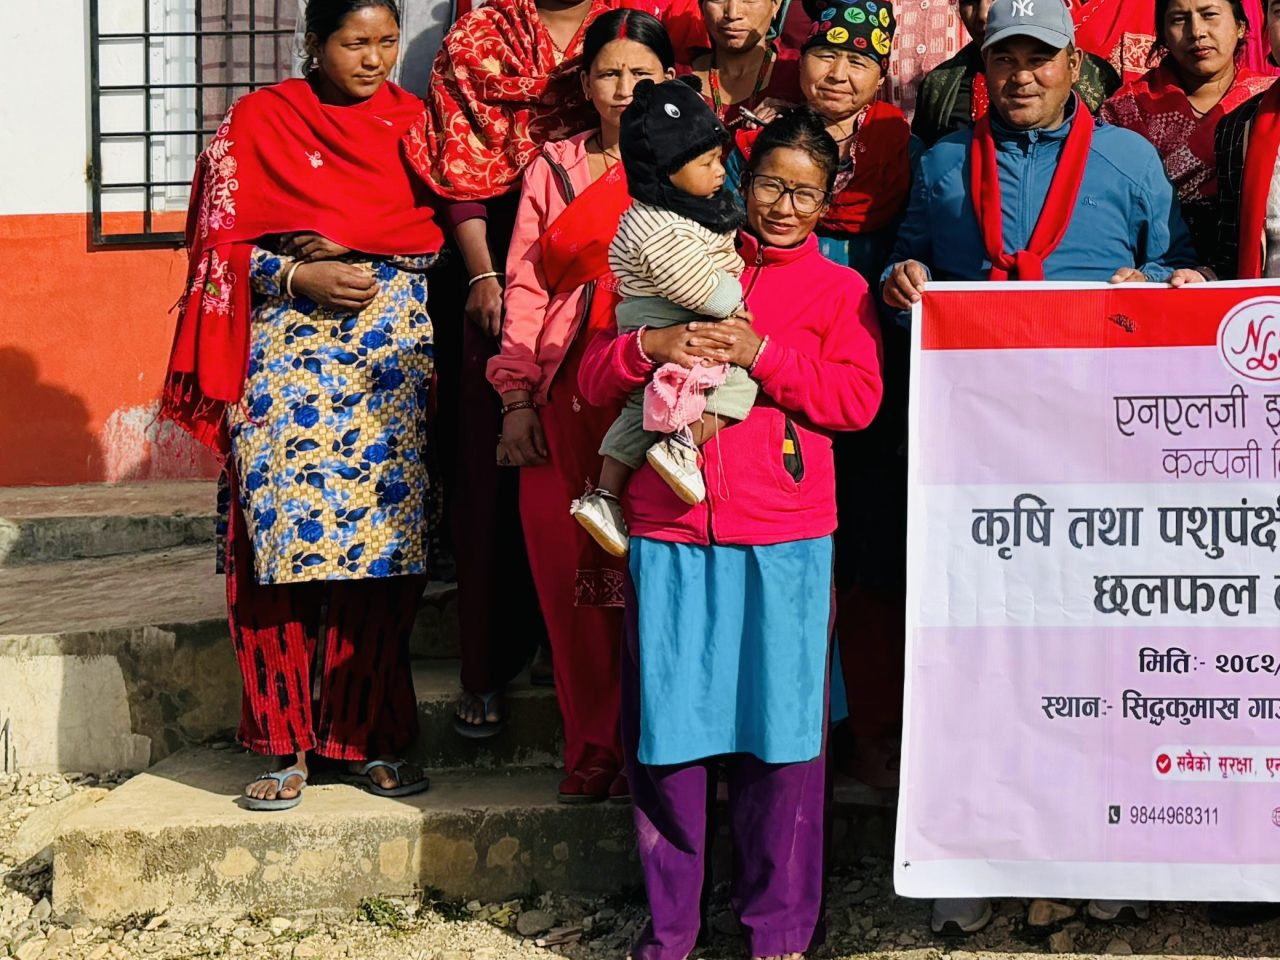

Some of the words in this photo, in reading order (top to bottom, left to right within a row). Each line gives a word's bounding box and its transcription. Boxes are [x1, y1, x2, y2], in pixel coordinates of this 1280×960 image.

[1113, 384, 1248, 436] एनएलजी
[1162, 438, 1262, 479] कम्पनी
[971, 493, 1054, 560] कृषि
[1068, 506, 1143, 546] तथा
[1093, 574, 1259, 616] छलफल
[1176, 748, 1211, 775] सबैको
[1129, 806, 1219, 826] 9844968311
